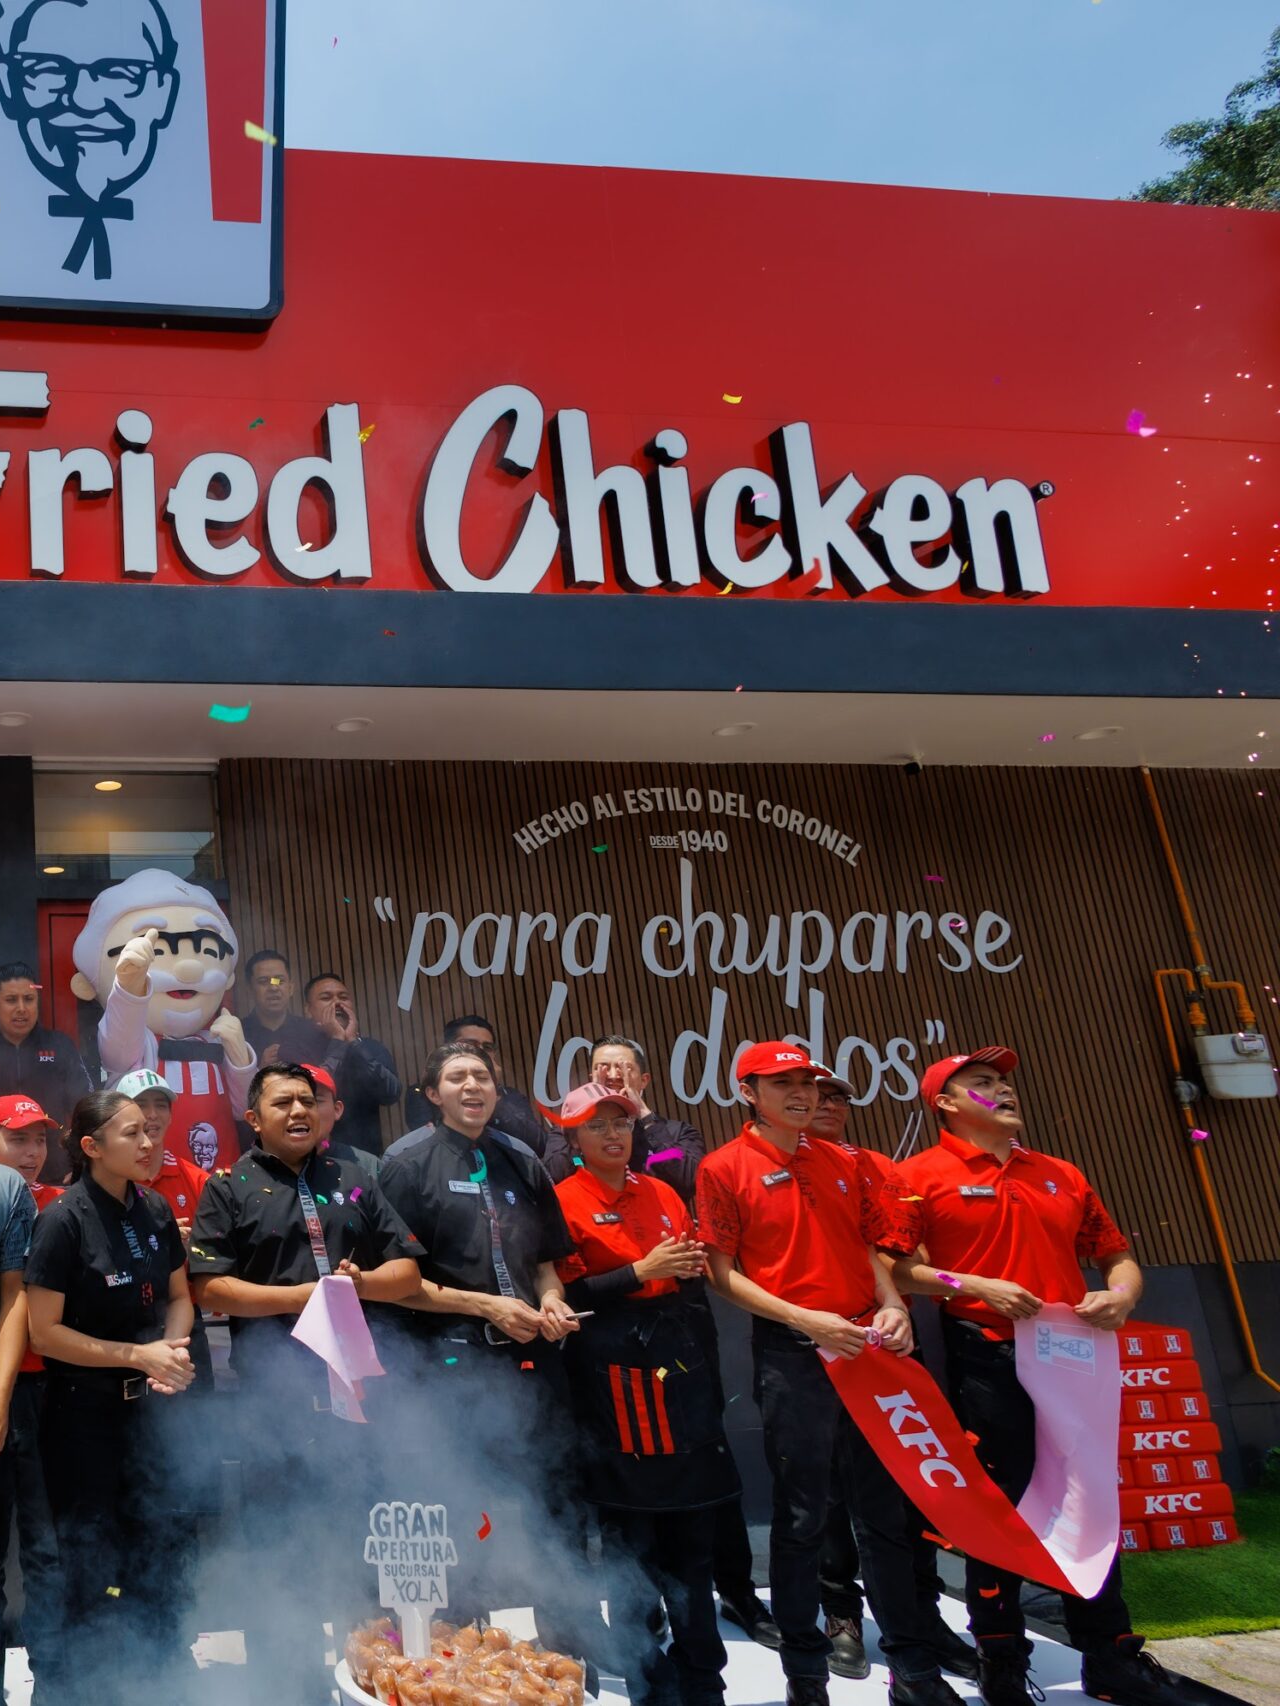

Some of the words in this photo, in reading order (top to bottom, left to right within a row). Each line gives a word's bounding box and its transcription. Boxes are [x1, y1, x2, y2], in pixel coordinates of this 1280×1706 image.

[512, 801, 589, 855] HECHO
[592, 793, 624, 820] AL
[624, 787, 702, 814] ESTILO
[707, 789, 751, 819] DEL
[756, 799, 863, 868] CORONEL
[649, 835, 678, 848] DESDE
[678, 830, 728, 853] 1940
[641, 857, 1023, 1009] chuparse
[776, 1053, 803, 1062] KFC
[1120, 1368, 1171, 1388] KFC
[874, 1389, 968, 1488] KFC
[1133, 1430, 1190, 1451] KFC
[1144, 1492, 1202, 1515] KFC
[374, 1506, 444, 1538] GRAN
[369, 1541, 456, 1563] APERTURA
[384, 1564, 441, 1577] SUCURSAL
